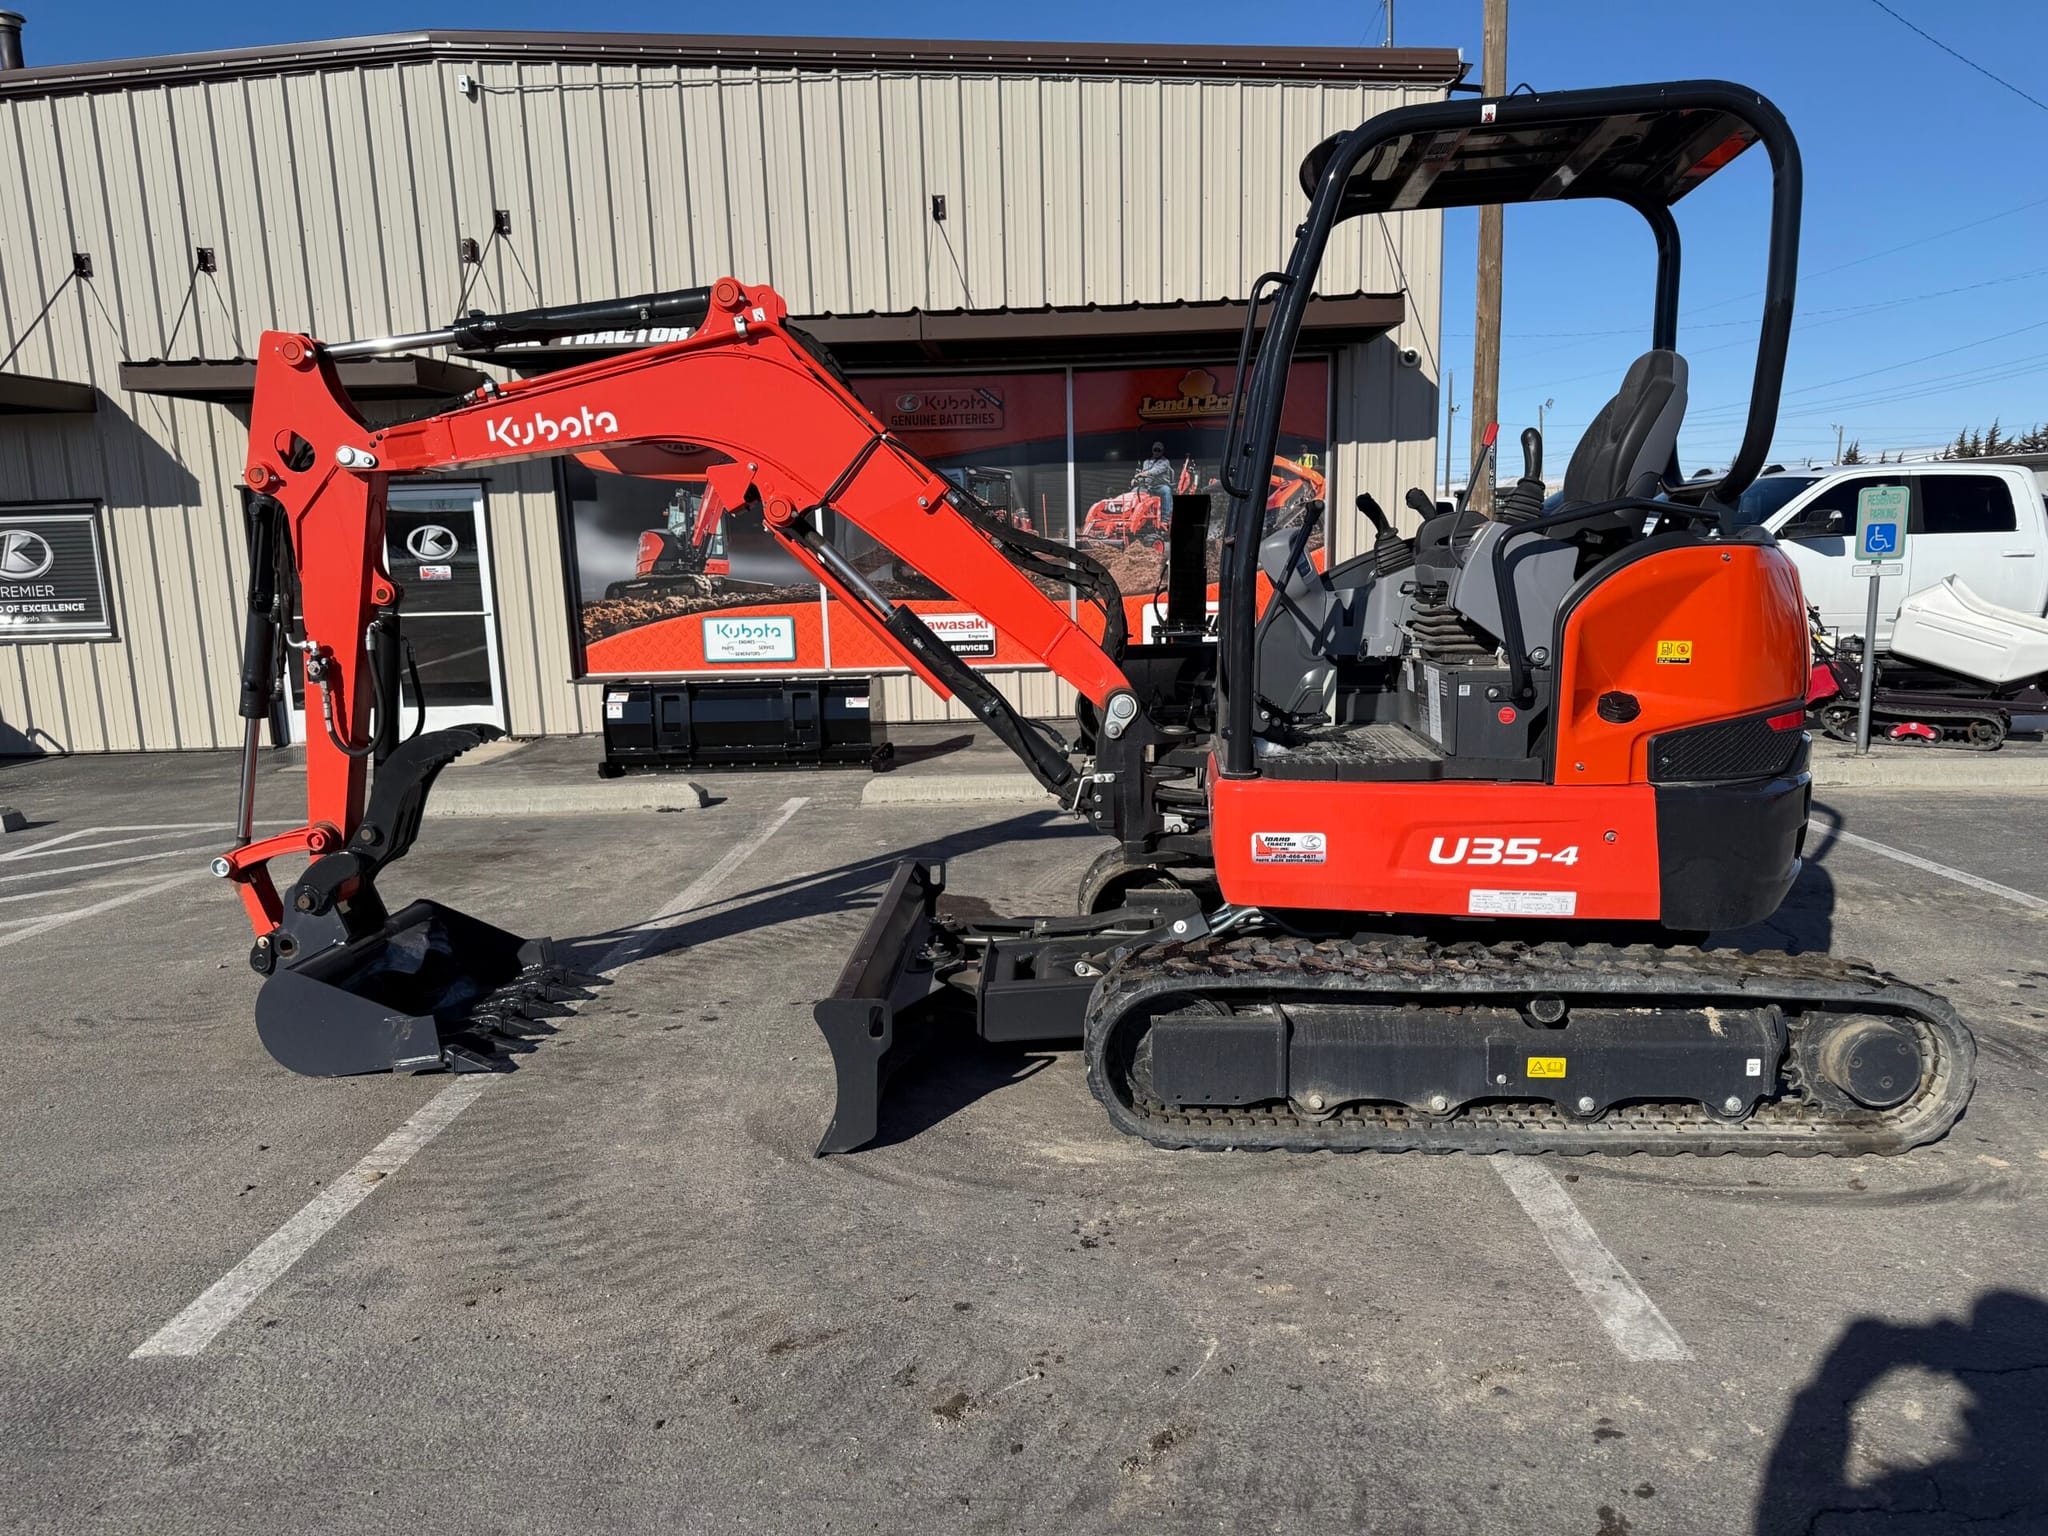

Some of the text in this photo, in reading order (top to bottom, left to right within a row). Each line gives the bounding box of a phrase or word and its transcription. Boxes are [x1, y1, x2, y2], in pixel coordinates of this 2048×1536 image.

[924, 394, 987, 409] Kubota
[1143, 393, 1247, 411] Land Pri
[891, 413, 995, 426] GENUINE BATTERIES
[486, 406, 618, 447] Kubota
[1867, 494, 1901, 505] RESERVED
[1870, 508, 1897, 519] PARKING
[0, 585, 55, 598] REMIER
[6, 605, 20, 613] OF
[22, 603, 86, 613] EXCELLENCE
[923, 618, 989, 630] awasaki
[716, 623, 782, 639] Kubota
[950, 644, 989, 652] SERVICES
[1429, 837, 1579, 866] U35-4
